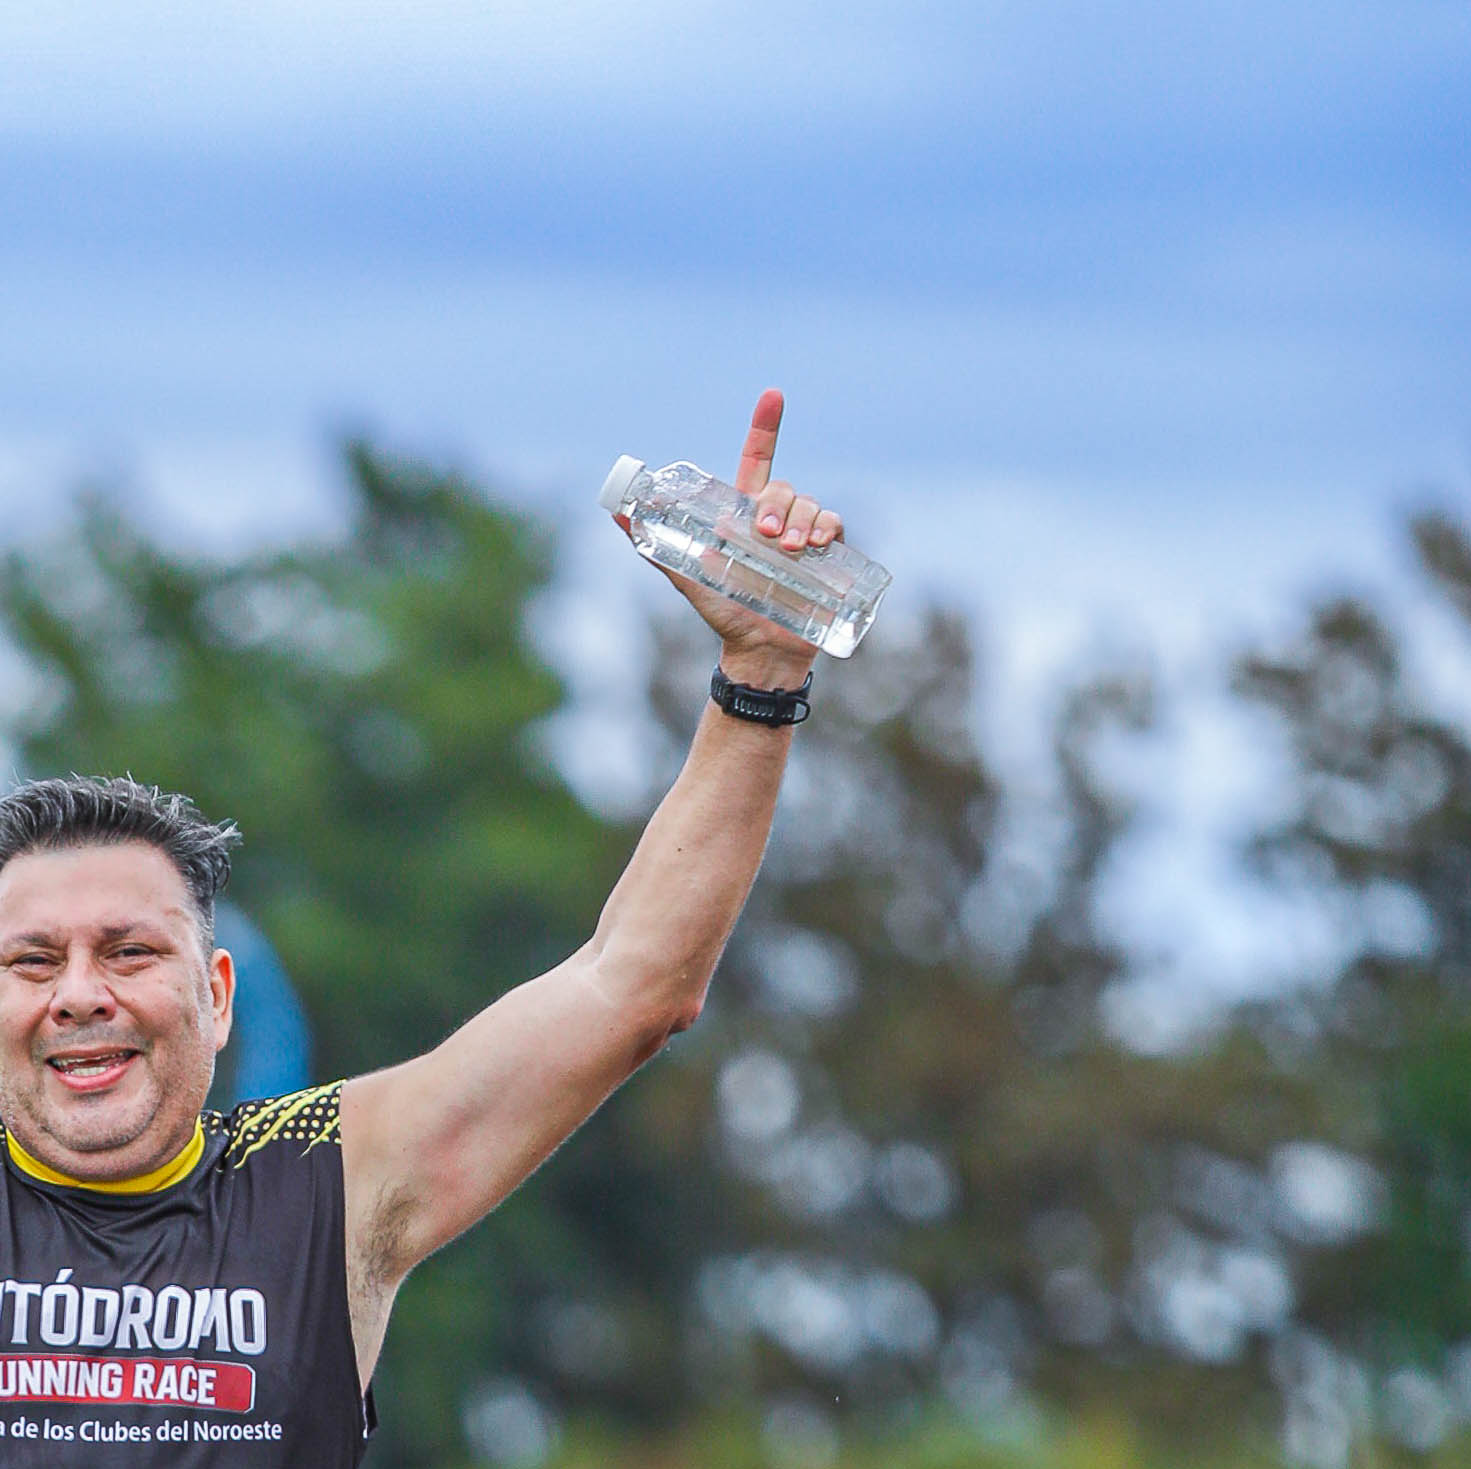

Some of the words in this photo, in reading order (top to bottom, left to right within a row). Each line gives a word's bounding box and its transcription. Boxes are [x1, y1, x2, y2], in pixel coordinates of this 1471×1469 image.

[132, 1363, 217, 1405] RACE
[10, 1416, 40, 1439] de
[44, 1418, 75, 1441] los
[79, 1420, 152, 1443] Clubes
[156, 1420, 189, 1443] del
[193, 1420, 283, 1442] Noroeste
